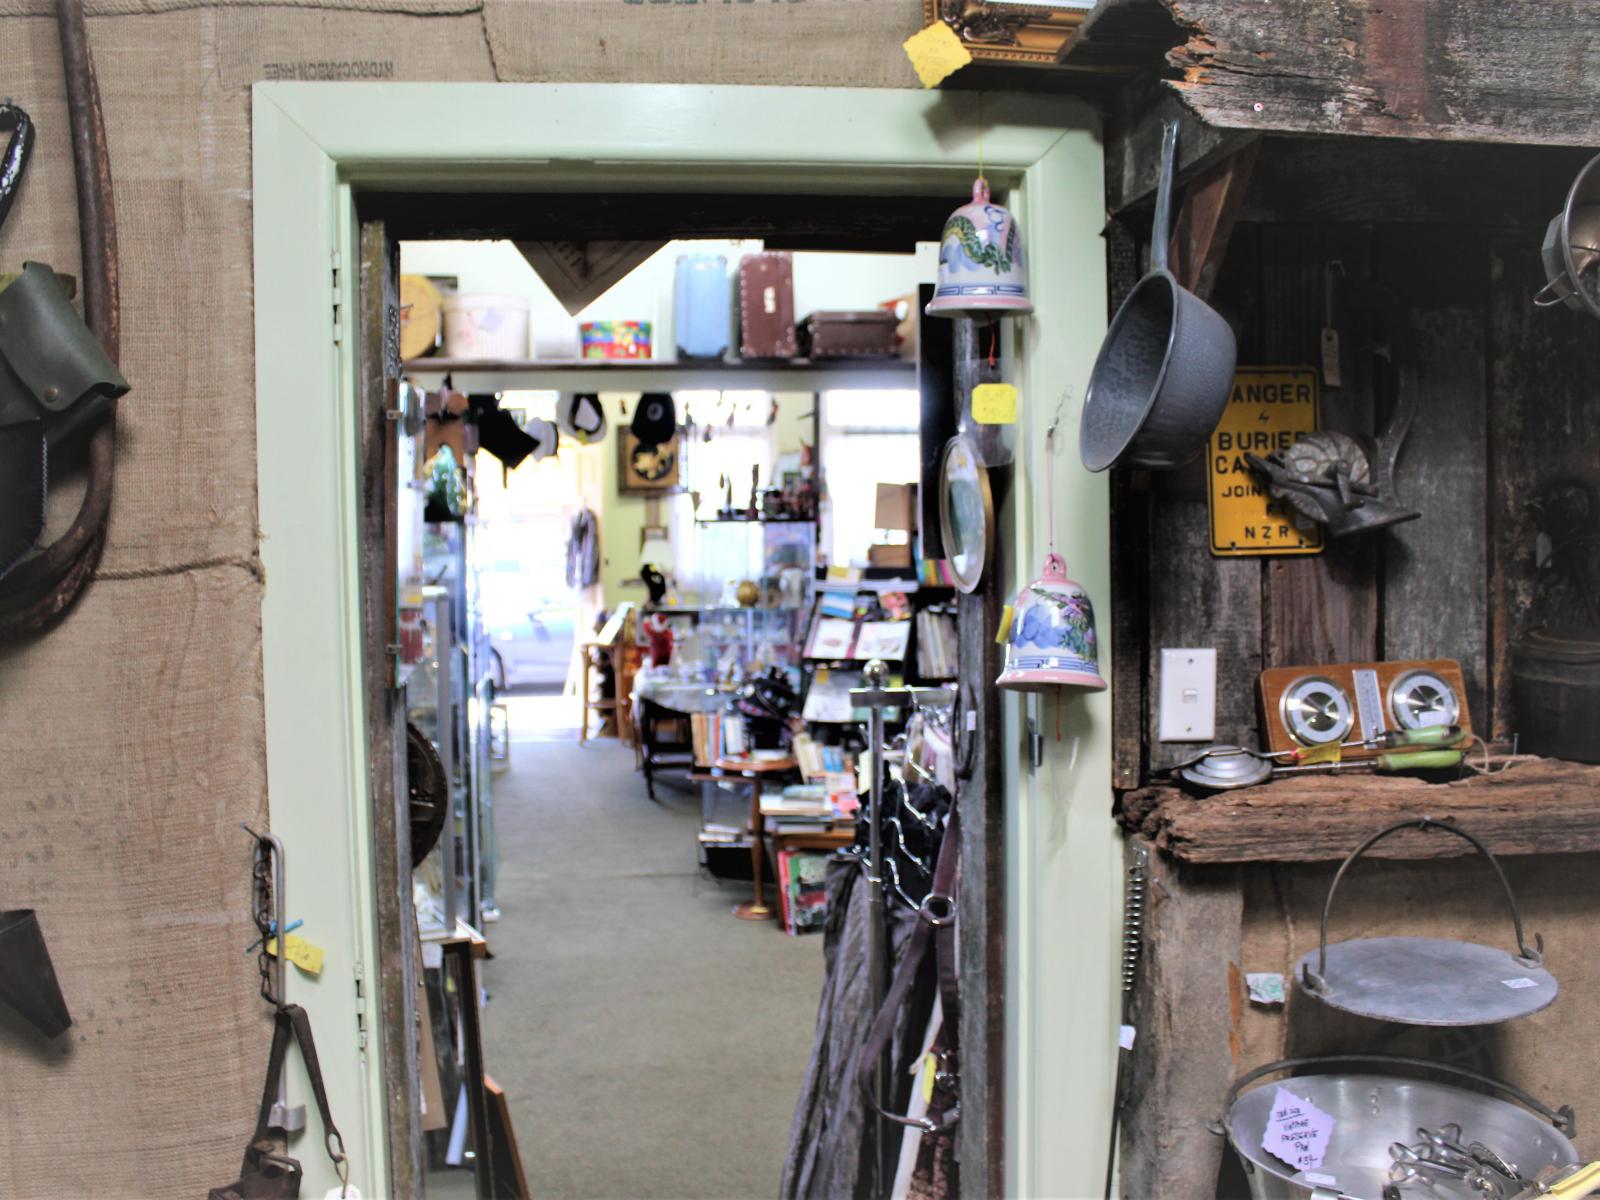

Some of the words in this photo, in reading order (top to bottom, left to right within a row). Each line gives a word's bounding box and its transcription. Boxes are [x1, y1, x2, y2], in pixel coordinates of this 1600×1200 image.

[263, 62, 297, 80] FREE
[300, 60, 394, 80] HYDROCARBON
[1232, 384, 1312, 404] ANGER
[1221, 485, 1263, 498] JOIN
